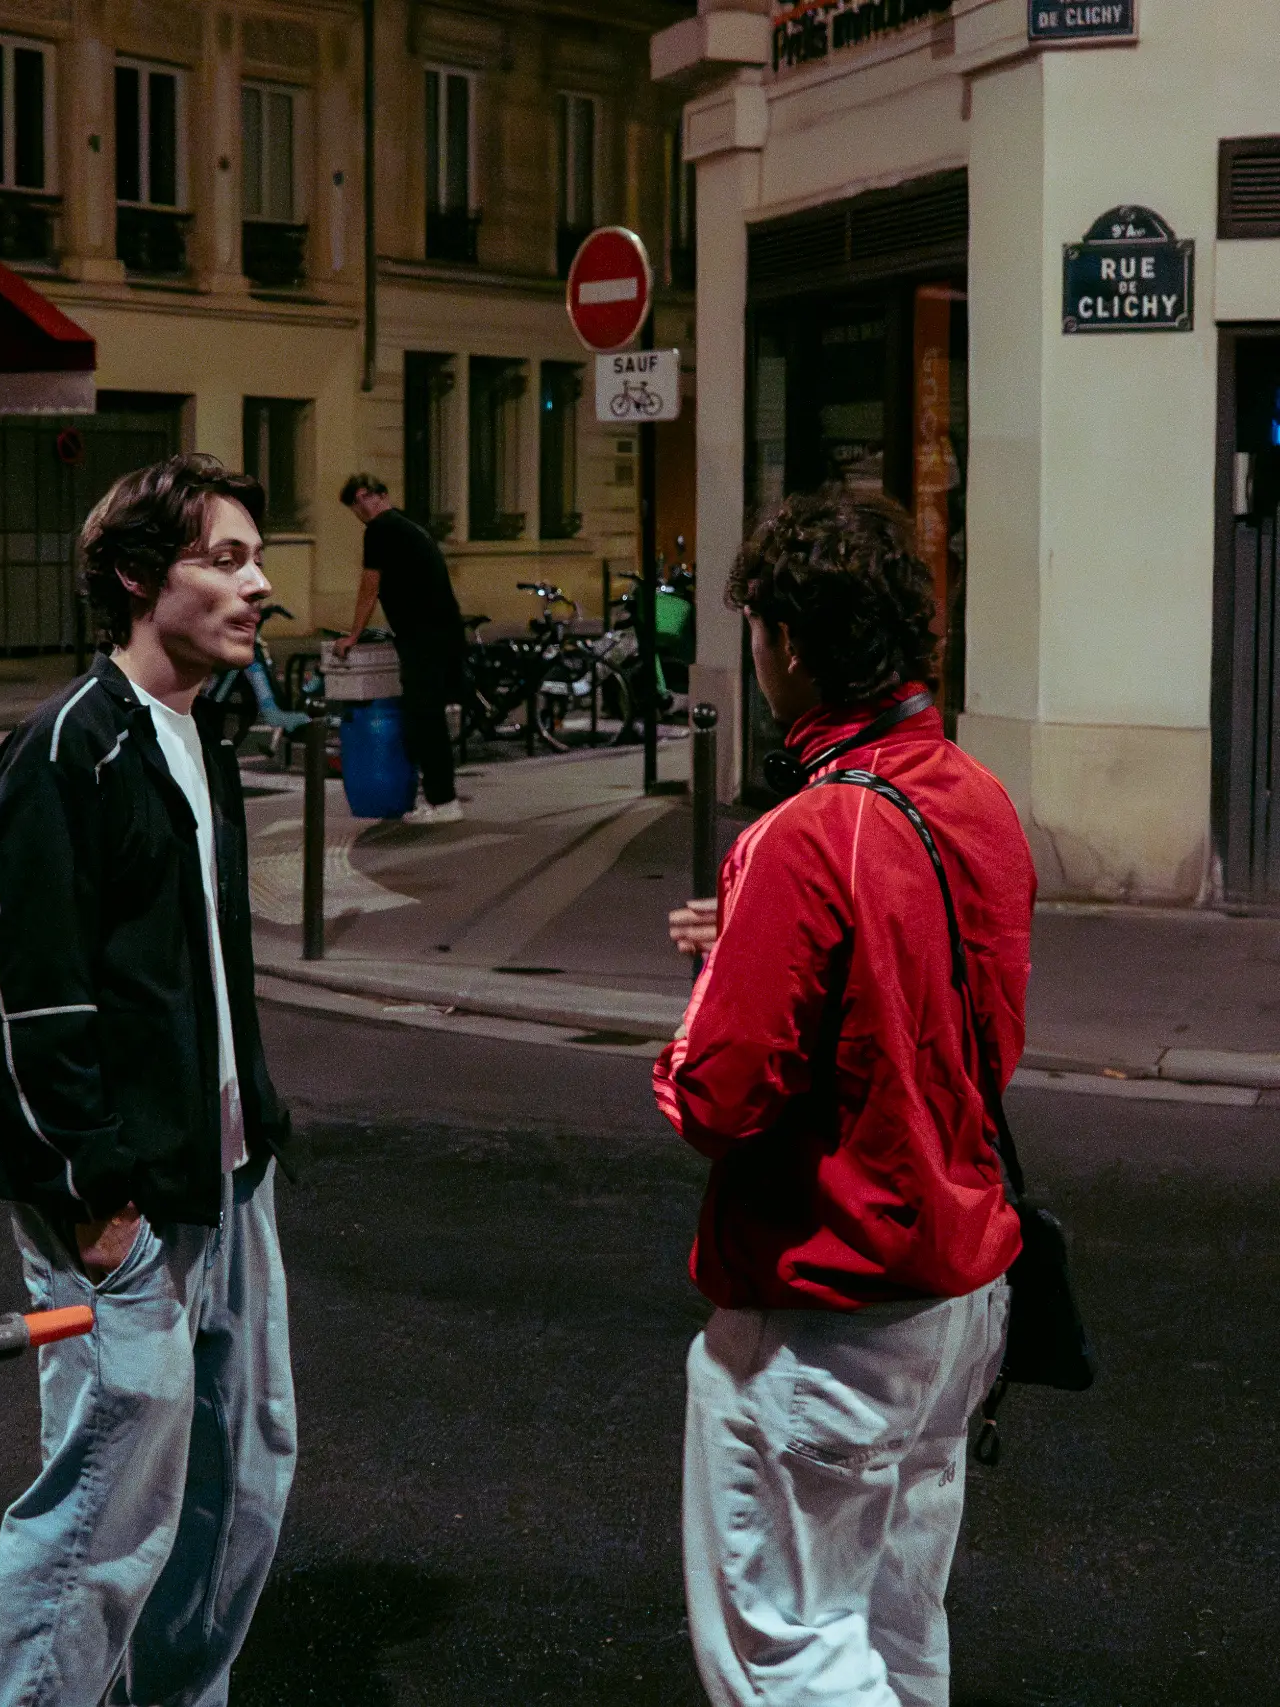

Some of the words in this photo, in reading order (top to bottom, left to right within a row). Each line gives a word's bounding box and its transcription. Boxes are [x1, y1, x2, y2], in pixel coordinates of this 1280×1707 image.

[1038, 11, 1059, 28] DE
[1065, 4, 1123, 27] CLICHY
[1101, 256, 1156, 280] RUE
[1118, 280, 1137, 295] DE
[1078, 293, 1178, 319] CLICHY
[614, 355, 658, 374] SAUF
